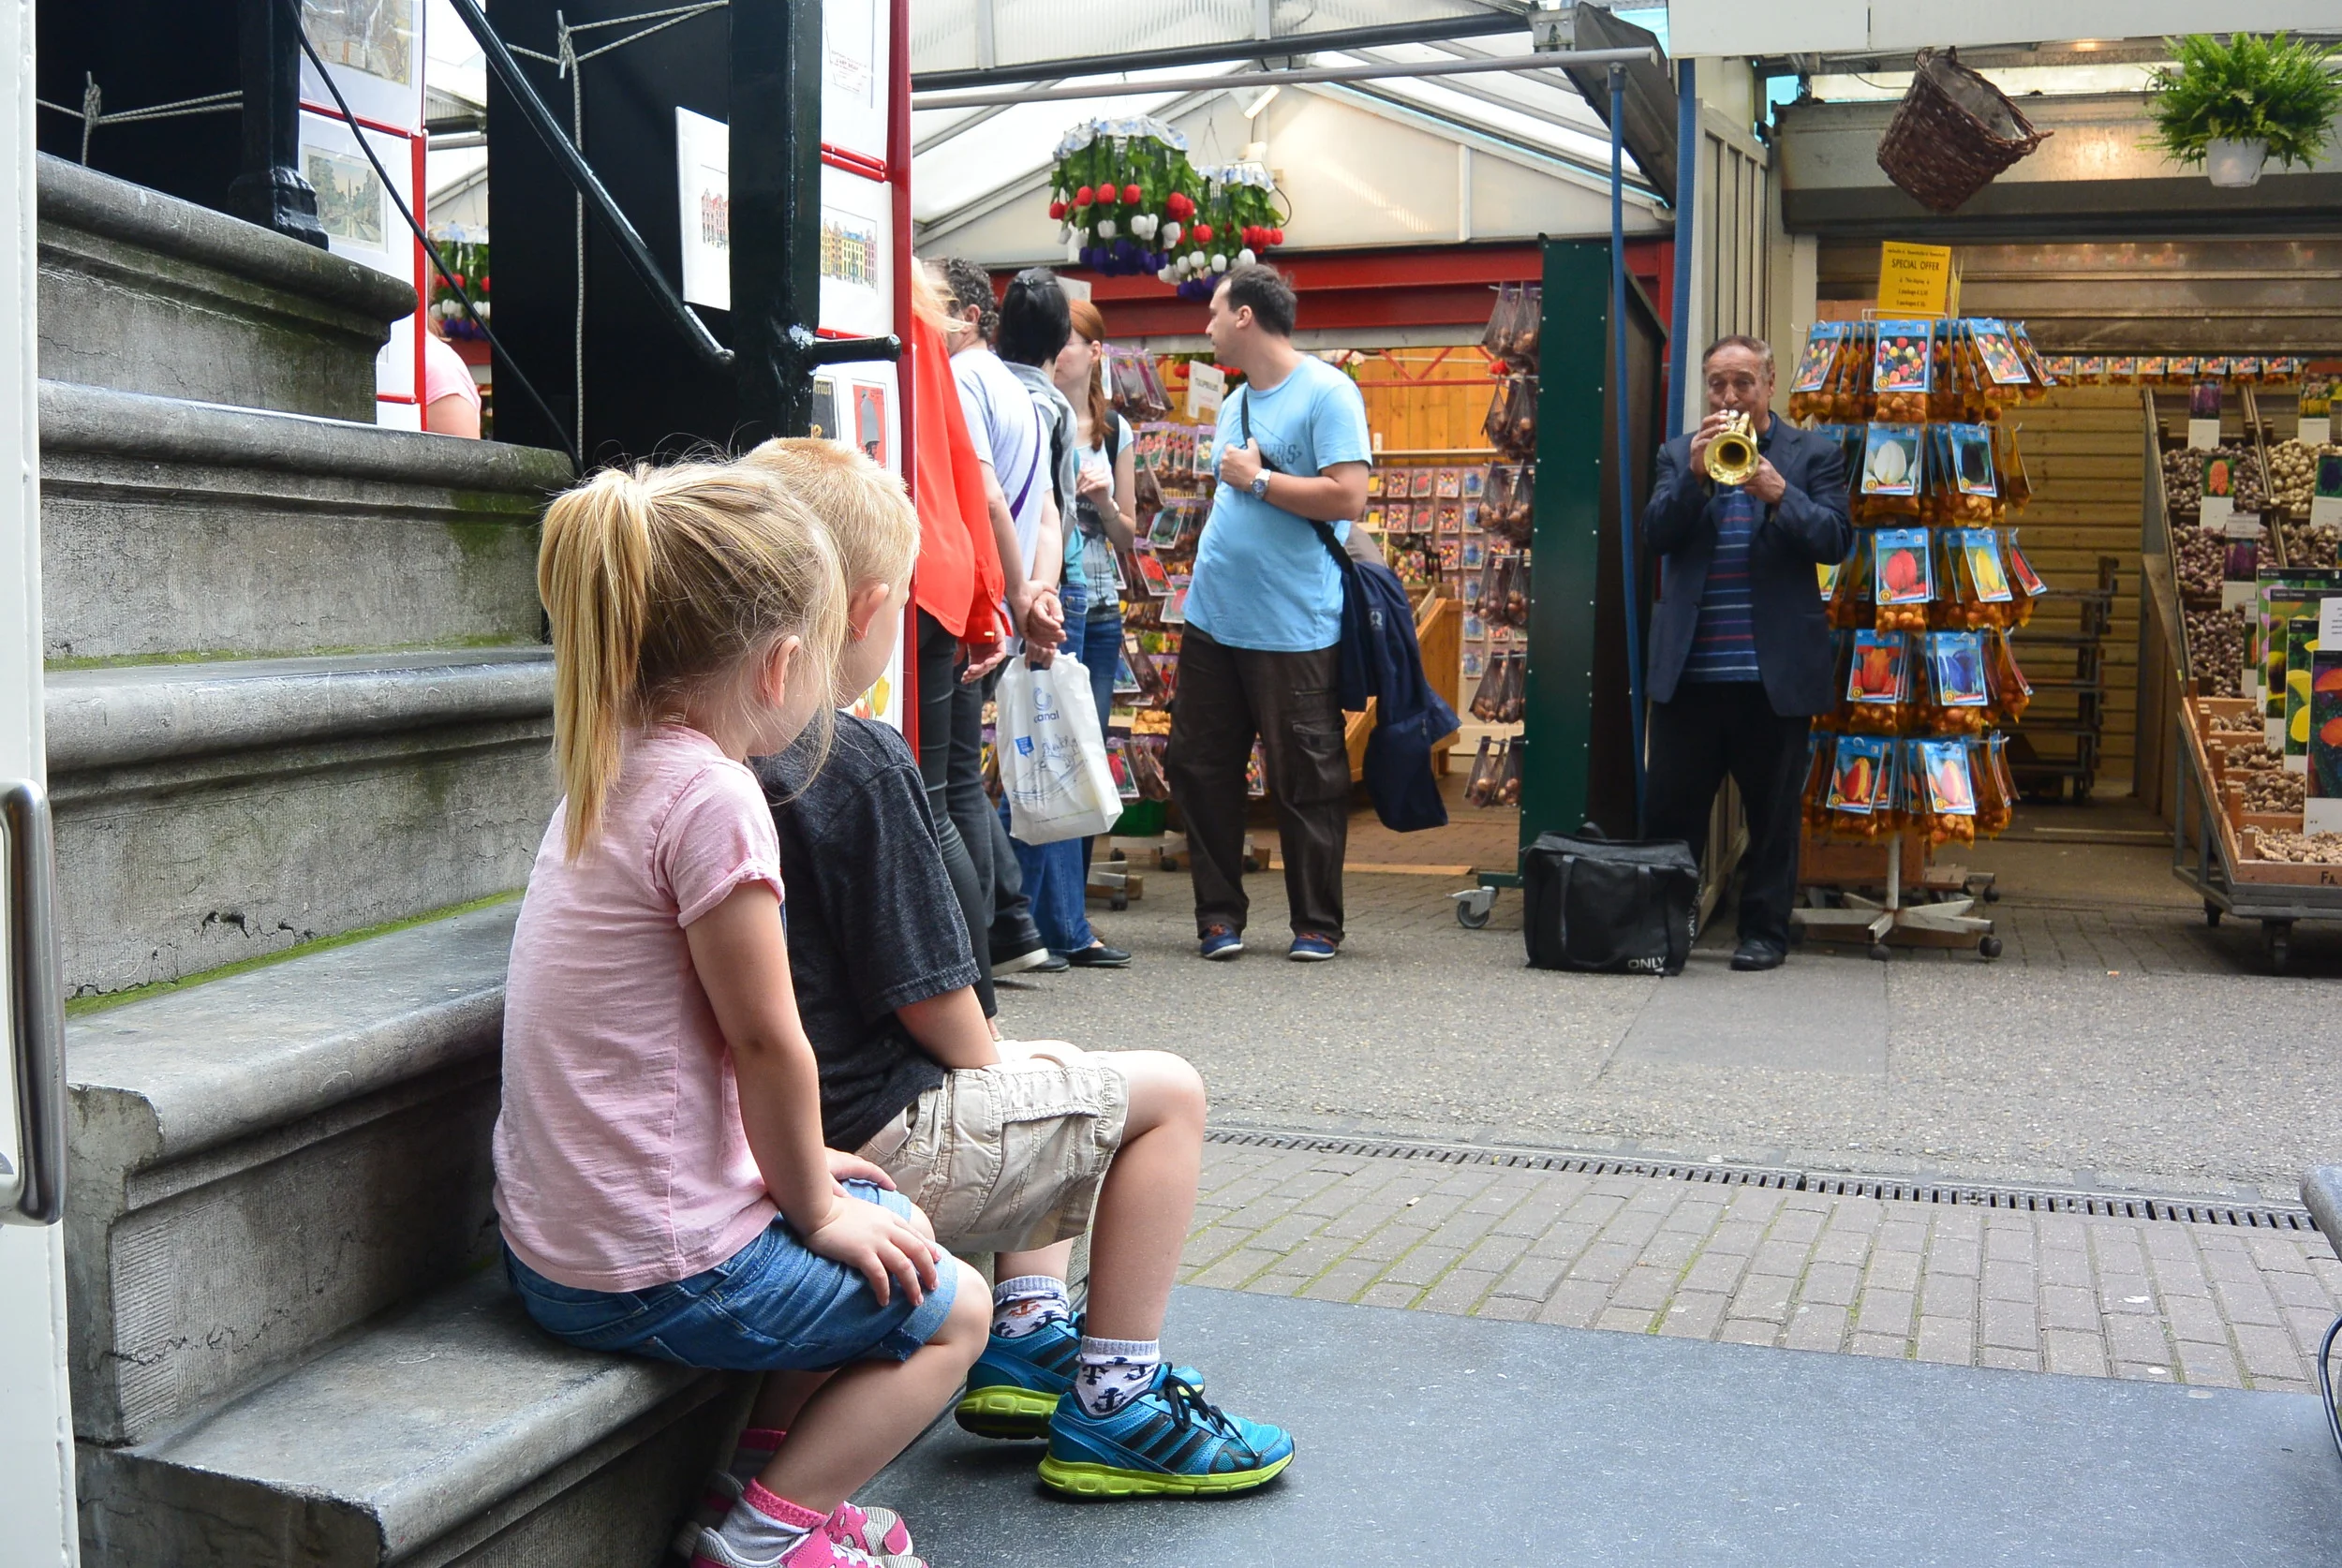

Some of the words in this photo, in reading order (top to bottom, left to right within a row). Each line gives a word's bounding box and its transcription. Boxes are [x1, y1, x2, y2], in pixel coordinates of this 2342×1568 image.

[1891, 259, 1918, 271] SPECIAL
[1920, 260, 1940, 271] OFFER
[1627, 955, 1666, 970] ONLY
